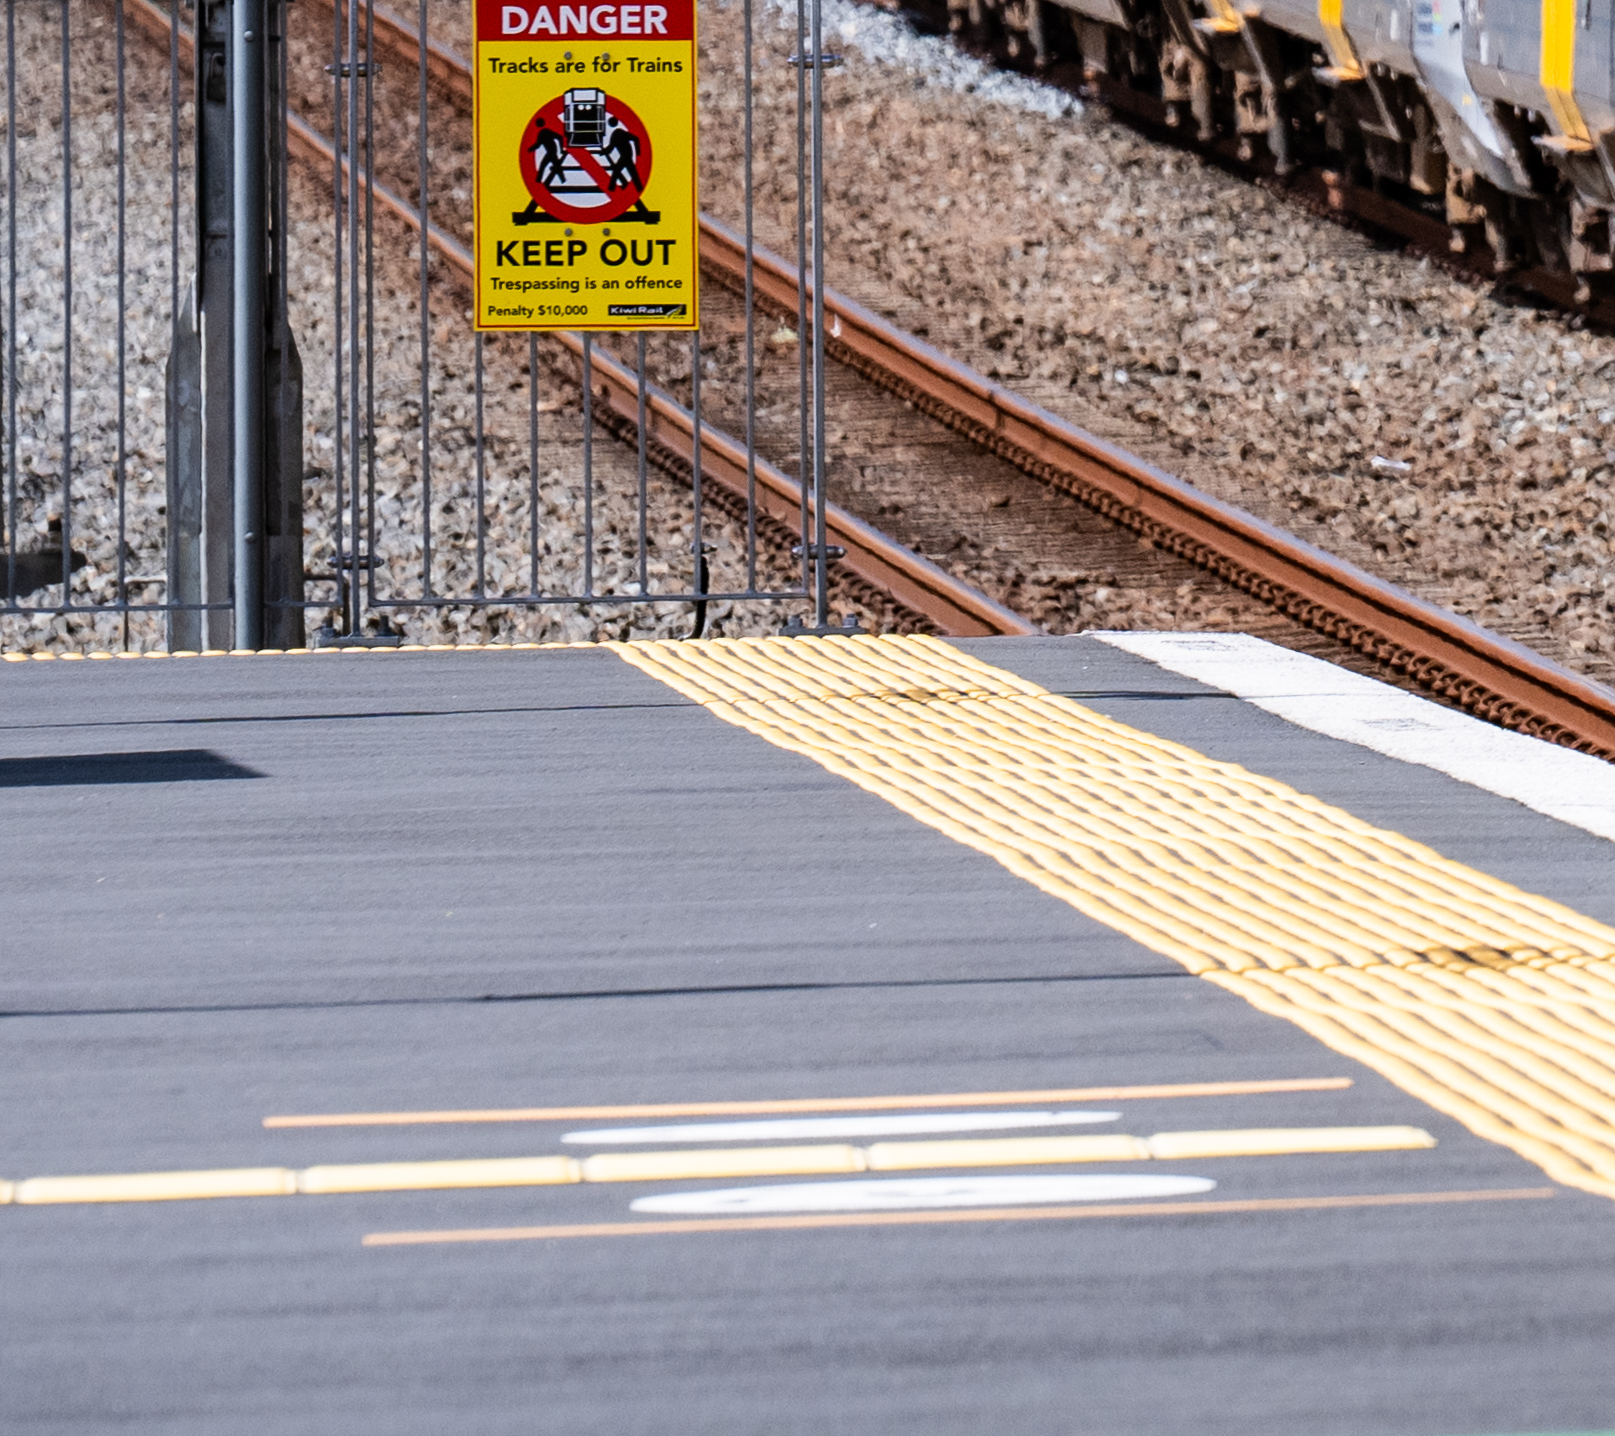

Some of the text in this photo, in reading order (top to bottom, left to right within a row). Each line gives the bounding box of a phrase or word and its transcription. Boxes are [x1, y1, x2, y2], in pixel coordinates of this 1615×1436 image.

[501, 5, 668, 35] DANGER
[488, 56, 683, 74] Tracks are for Trains
[496, 238, 676, 267] KEEP OUT
[490, 276, 682, 294] Trespassing is an offence
[488, 304, 588, 320] Penalty $10,000
